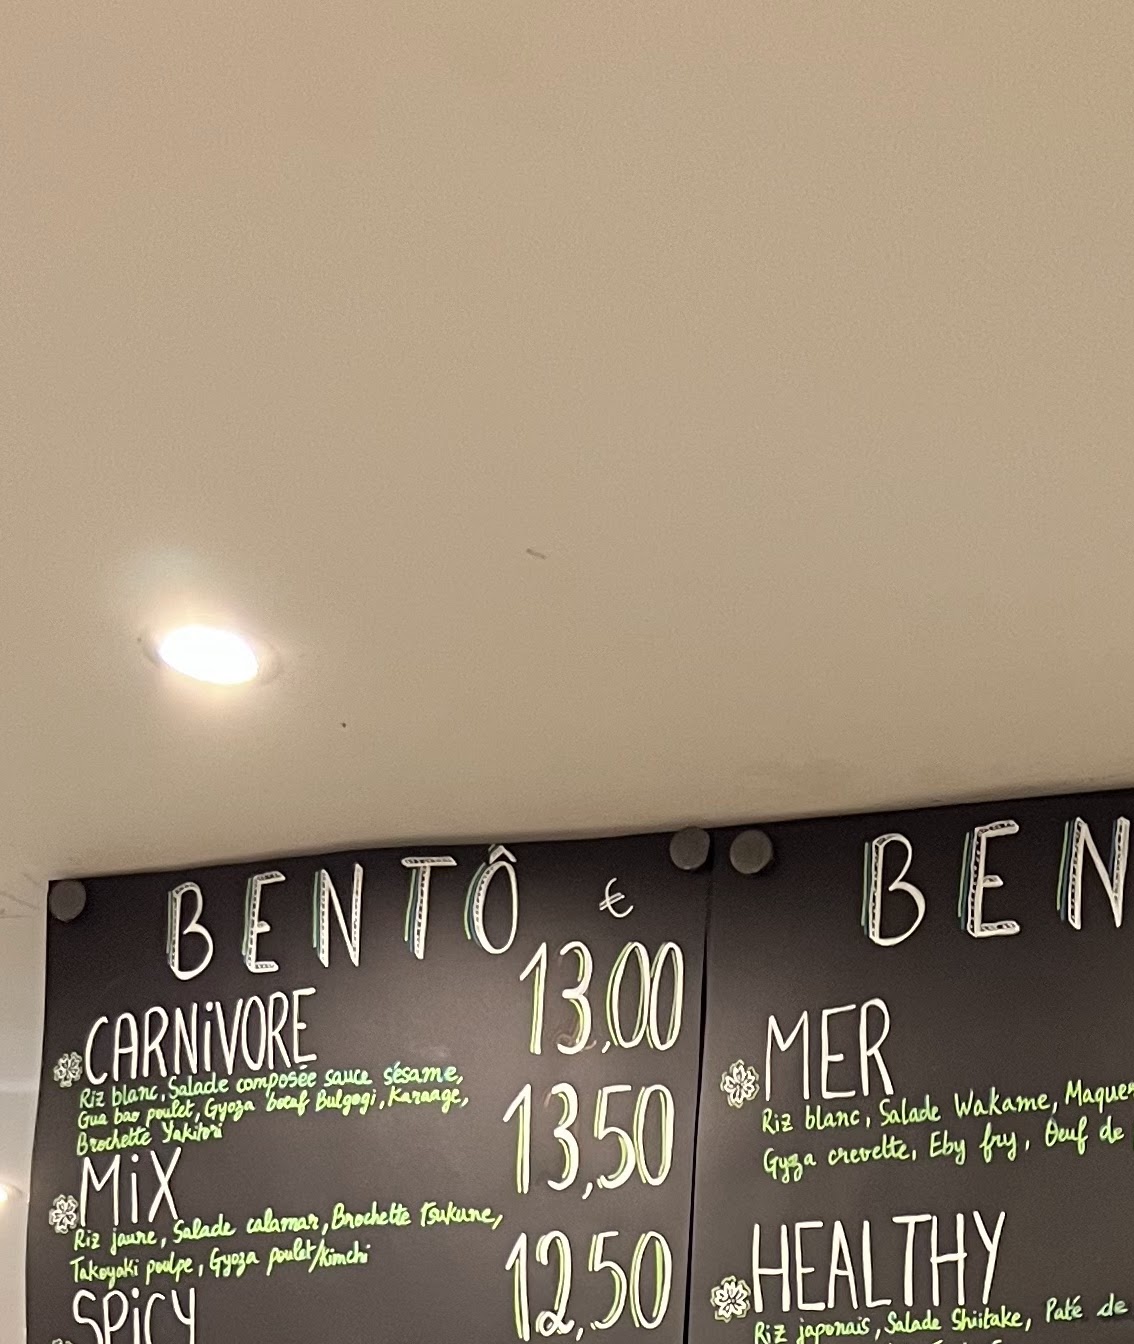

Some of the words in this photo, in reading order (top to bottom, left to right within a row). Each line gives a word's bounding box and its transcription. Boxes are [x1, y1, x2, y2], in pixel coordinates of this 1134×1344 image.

[166, 843, 518, 982] BENTÔ
[600, 878, 633, 918] €
[519, 941, 684, 1055] 13,00
[765, 997, 894, 1101] MER
[80, 1088, 104, 1108] Riz
[168, 1072, 229, 1099] Salade
[236, 1064, 316, 1097] composée
[78, 1111, 107, 1129] Gua
[114, 1107, 140, 1123] bao
[205, 1097, 255, 1121] Gyoza
[762, 1108, 794, 1135] Riz
[879, 1094, 942, 1126] Salade
[76, 1125, 152, 1156] Brochette
[162, 1120, 223, 1143] Yakitori
[503, 1083, 675, 1200] 13,50
[929, 1130, 966, 1165] Eby
[1100, 1116, 1124, 1143] de
[74, 1228, 100, 1250] Riz
[173, 1213, 236, 1243] Salade
[331, 1201, 411, 1230] Brochette
[69, 1256, 140, 1289] Takoyaki
[210, 1247, 259, 1278] Gyoza
[505, 1231, 672, 1341] 12,50
[752, 1210, 1006, 1313] HEALTHY
[887, 1310, 942, 1335] Salade
[1096, 1293, 1129, 1318] de
